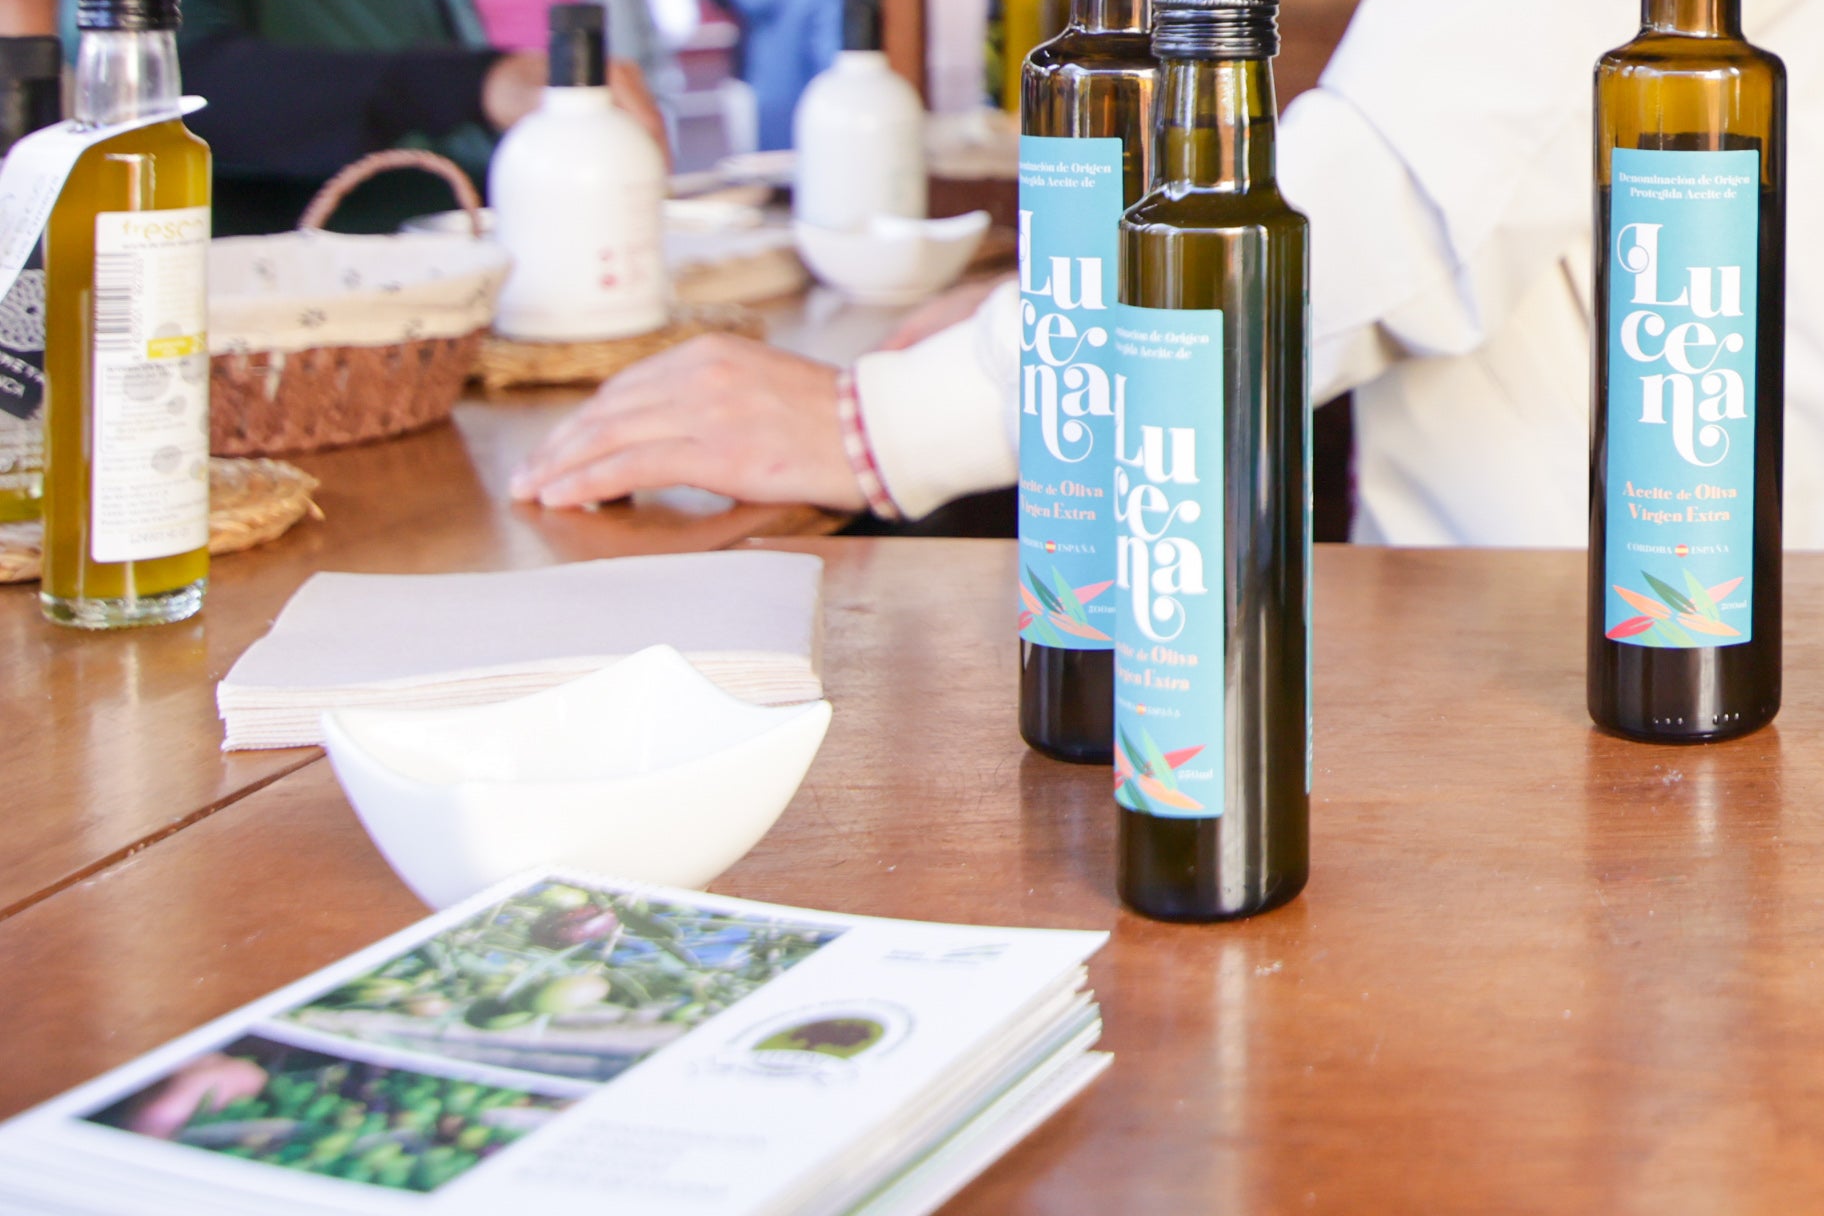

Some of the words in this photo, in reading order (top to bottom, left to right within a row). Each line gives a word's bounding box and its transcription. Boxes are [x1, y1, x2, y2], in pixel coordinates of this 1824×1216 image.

[1071, 163, 1112, 175] Origen
[1047, 176, 1079, 188] Aceite
[1698, 174, 1713, 185] de
[1714, 175, 1751, 187] Origen
[1630, 187, 1683, 201] Protegida
[1685, 188, 1722, 200] Aceite
[1723, 187, 1737, 199] de
[1616, 222, 1745, 319] Lu
[1164, 332, 1210, 346] Origen
[1620, 310, 1744, 375] ce
[1023, 363, 1115, 463] na
[1637, 368, 1748, 467] na
[1060, 480, 1104, 498] Oliva
[1622, 480, 1673, 501] Aceite
[1676, 489, 1692, 501] de
[1694, 483, 1738, 501] Oliva
[1053, 502, 1097, 521] Extra
[1628, 502, 1683, 524] Virgen
[1686, 505, 1731, 523] Extra
[1116, 535, 1209, 643] na
[1151, 645, 1200, 667] Oliva
[1144, 668, 1191, 691] Extra
